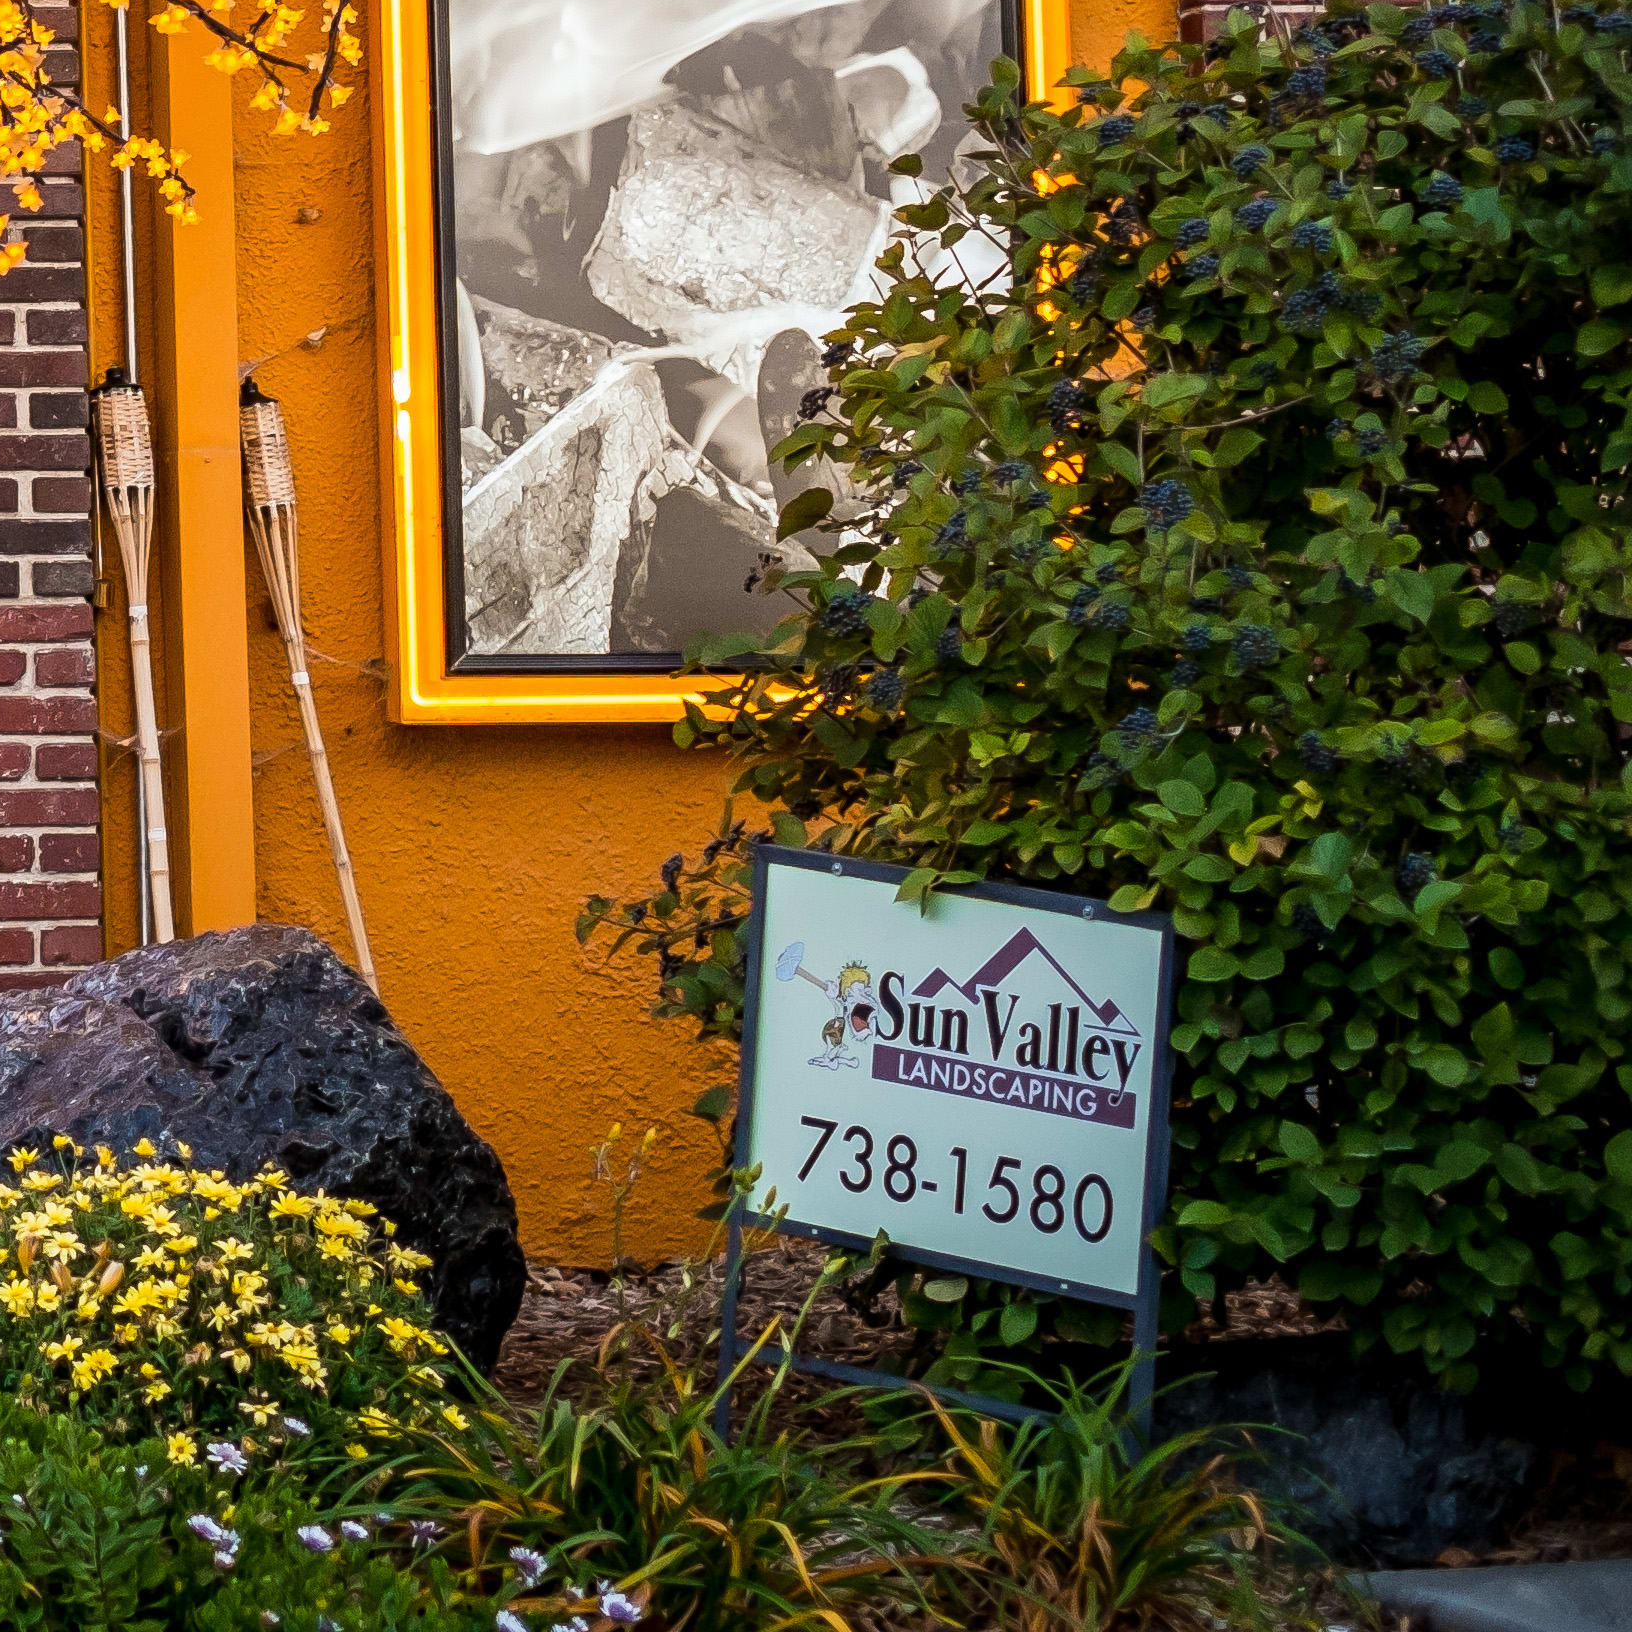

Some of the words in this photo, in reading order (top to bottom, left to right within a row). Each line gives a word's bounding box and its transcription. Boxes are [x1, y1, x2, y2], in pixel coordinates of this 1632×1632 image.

[876, 971, 970, 1056] Sun
[979, 986, 1142, 1107] Valley
[898, 1052, 1098, 1117] LANDSCAPING
[796, 1115, 1115, 1244] 738-1580
